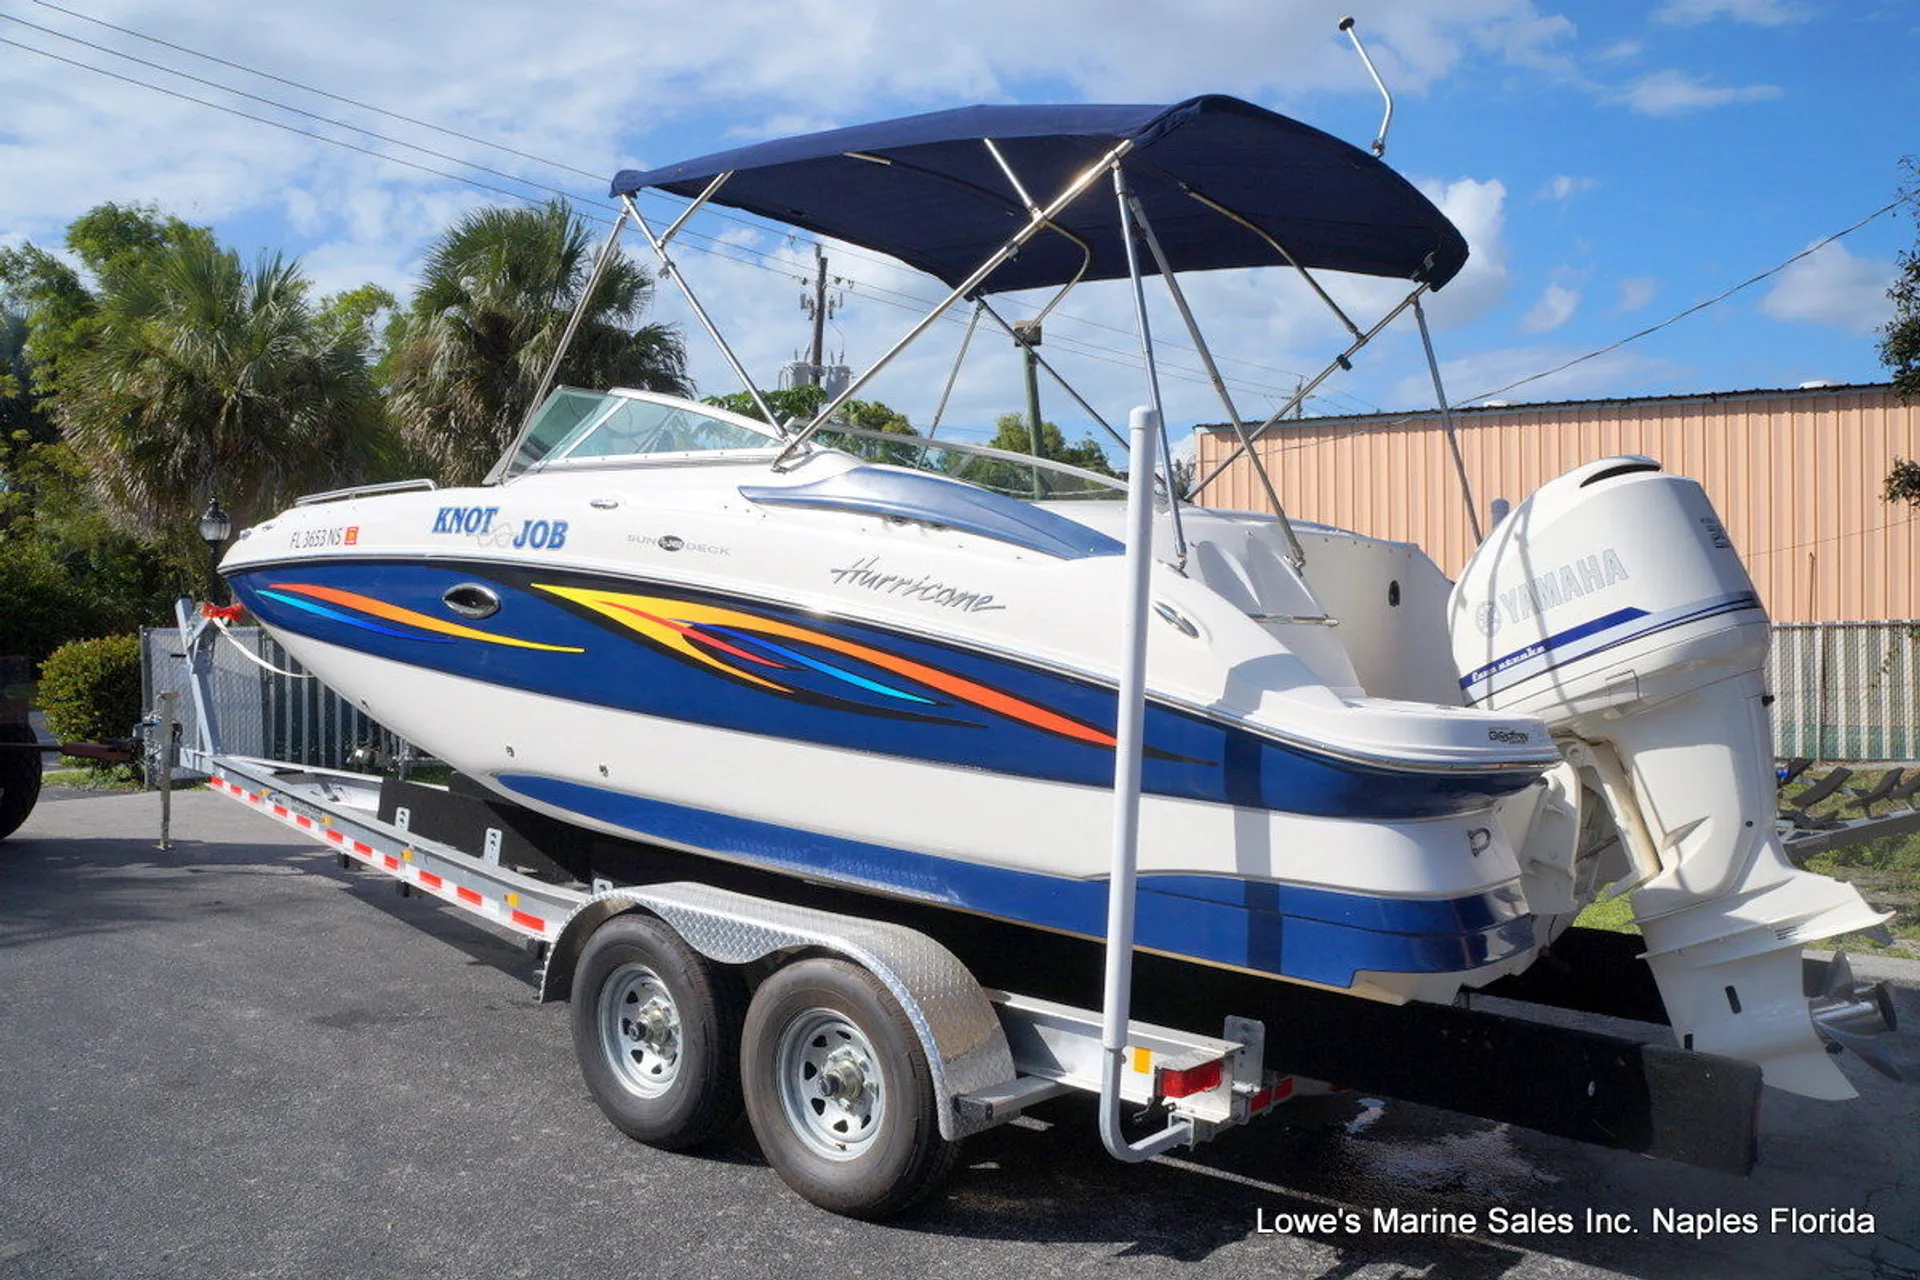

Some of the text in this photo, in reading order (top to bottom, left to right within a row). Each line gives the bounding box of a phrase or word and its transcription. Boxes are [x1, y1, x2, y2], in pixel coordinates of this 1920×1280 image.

[290, 527, 342, 548] FL 3653 NS
[432, 506, 569, 549] KNOT JOB
[627, 533, 657, 547] SUN
[686, 542, 731, 557] DECK
[830, 556, 1006, 612] Hurricane
[1498, 548, 1630, 624] YAMAHA
